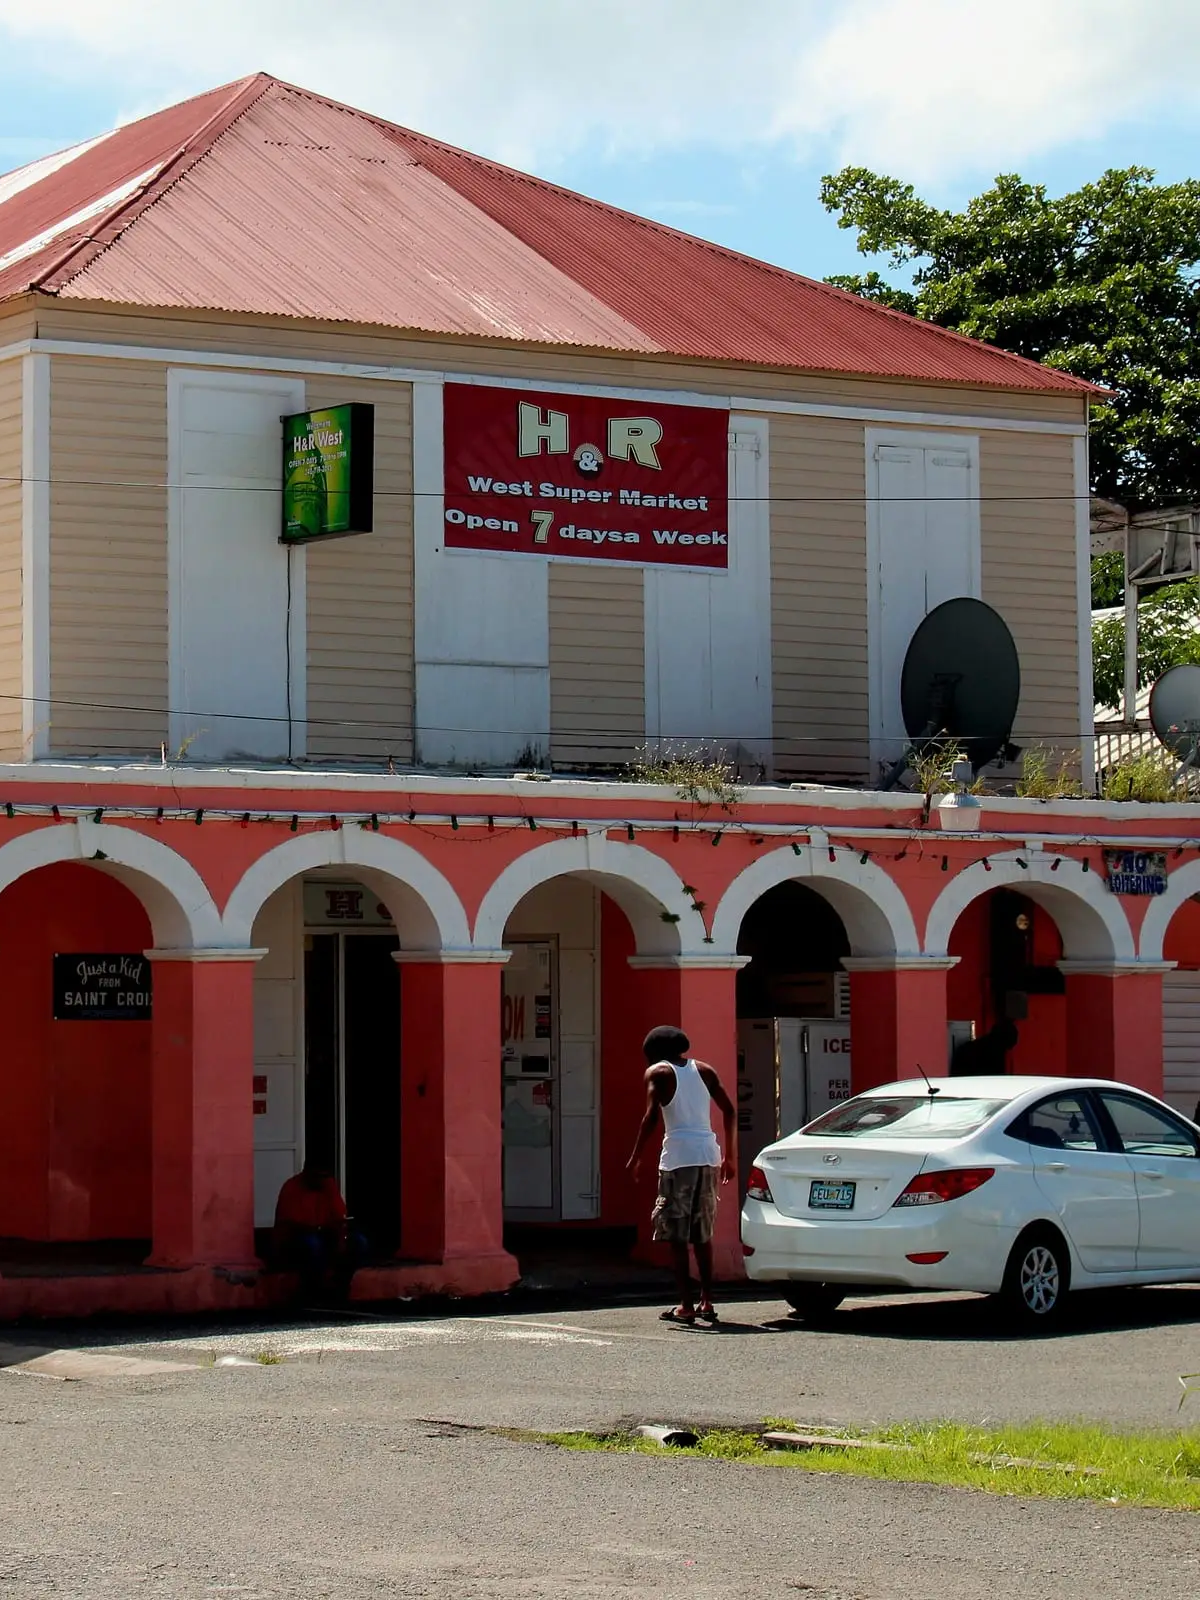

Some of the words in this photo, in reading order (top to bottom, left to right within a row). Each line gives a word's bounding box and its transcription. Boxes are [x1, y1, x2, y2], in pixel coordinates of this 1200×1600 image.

[293, 433, 315, 452] H&R
[318, 430, 343, 448] West
[518, 400, 569, 457] H
[578, 451, 598, 472] &
[607, 416, 663, 471] R
[467, 475, 533, 497] West
[539, 482, 612, 504] Super
[619, 489, 709, 512] Market
[445, 509, 519, 533] Open
[530, 510, 554, 543] 7
[652, 530, 728, 545] Week
[325, 890, 363, 919] H
[76, 961, 107, 985] Just
[109, 964, 117, 973] a
[119, 956, 143, 985] Kid
[98, 978, 121, 988] FROM
[64, 992, 107, 1006] SAINT
[823, 1039, 851, 1053] ICE
[828, 1079, 849, 1089] PER
[828, 1091, 850, 1100] BAG
